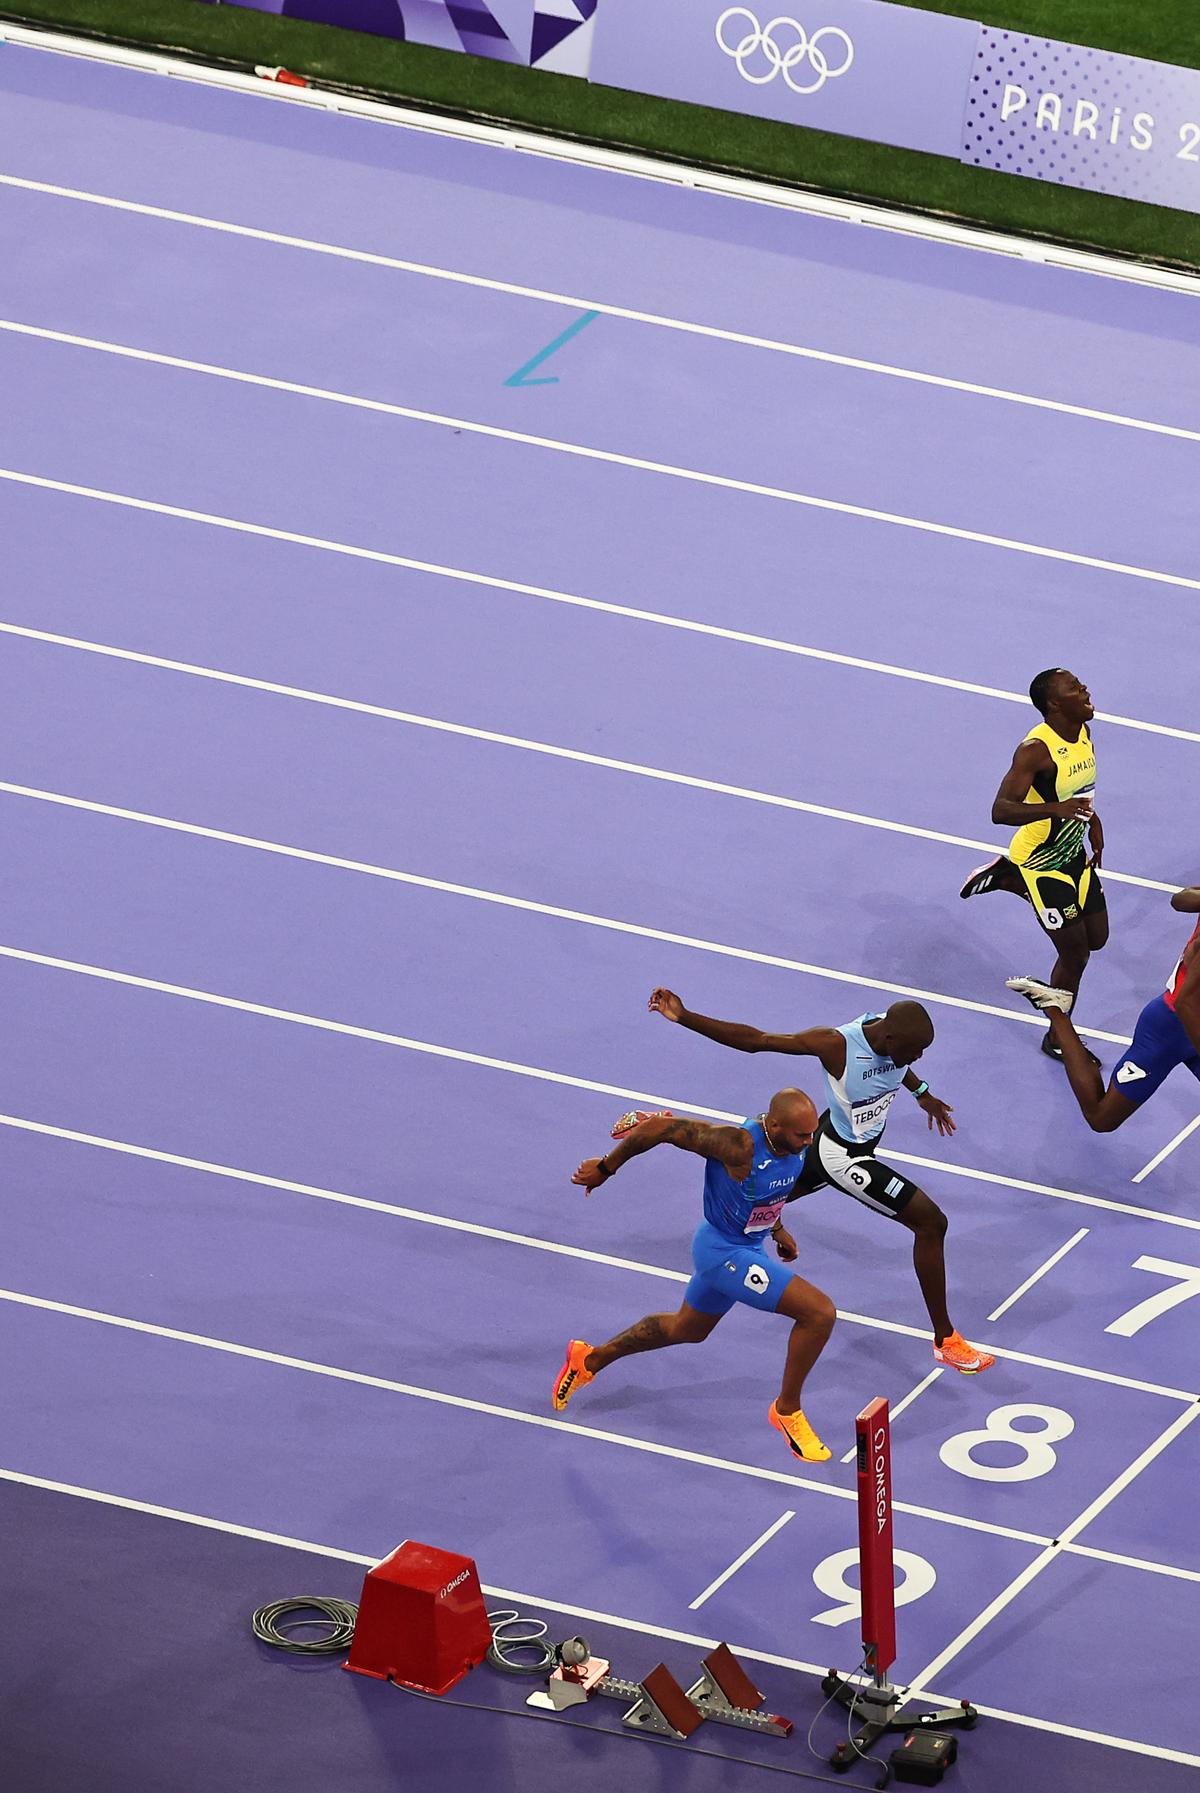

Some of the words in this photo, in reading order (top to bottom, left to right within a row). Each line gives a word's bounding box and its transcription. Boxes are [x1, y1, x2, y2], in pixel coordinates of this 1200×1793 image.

[1047, 911, 1058, 925] 6
[862, 1064, 896, 1080] BOTSWA
[768, 1175, 795, 1190] ITALIA
[850, 1172, 864, 1185] 8
[750, 1274, 764, 1285] 9
[939, 1403, 1075, 1482] 8
[875, 1456, 887, 1535] OMEGA
[446, 1569, 471, 1592] OMEGA
[809, 1547, 937, 1627] 9
